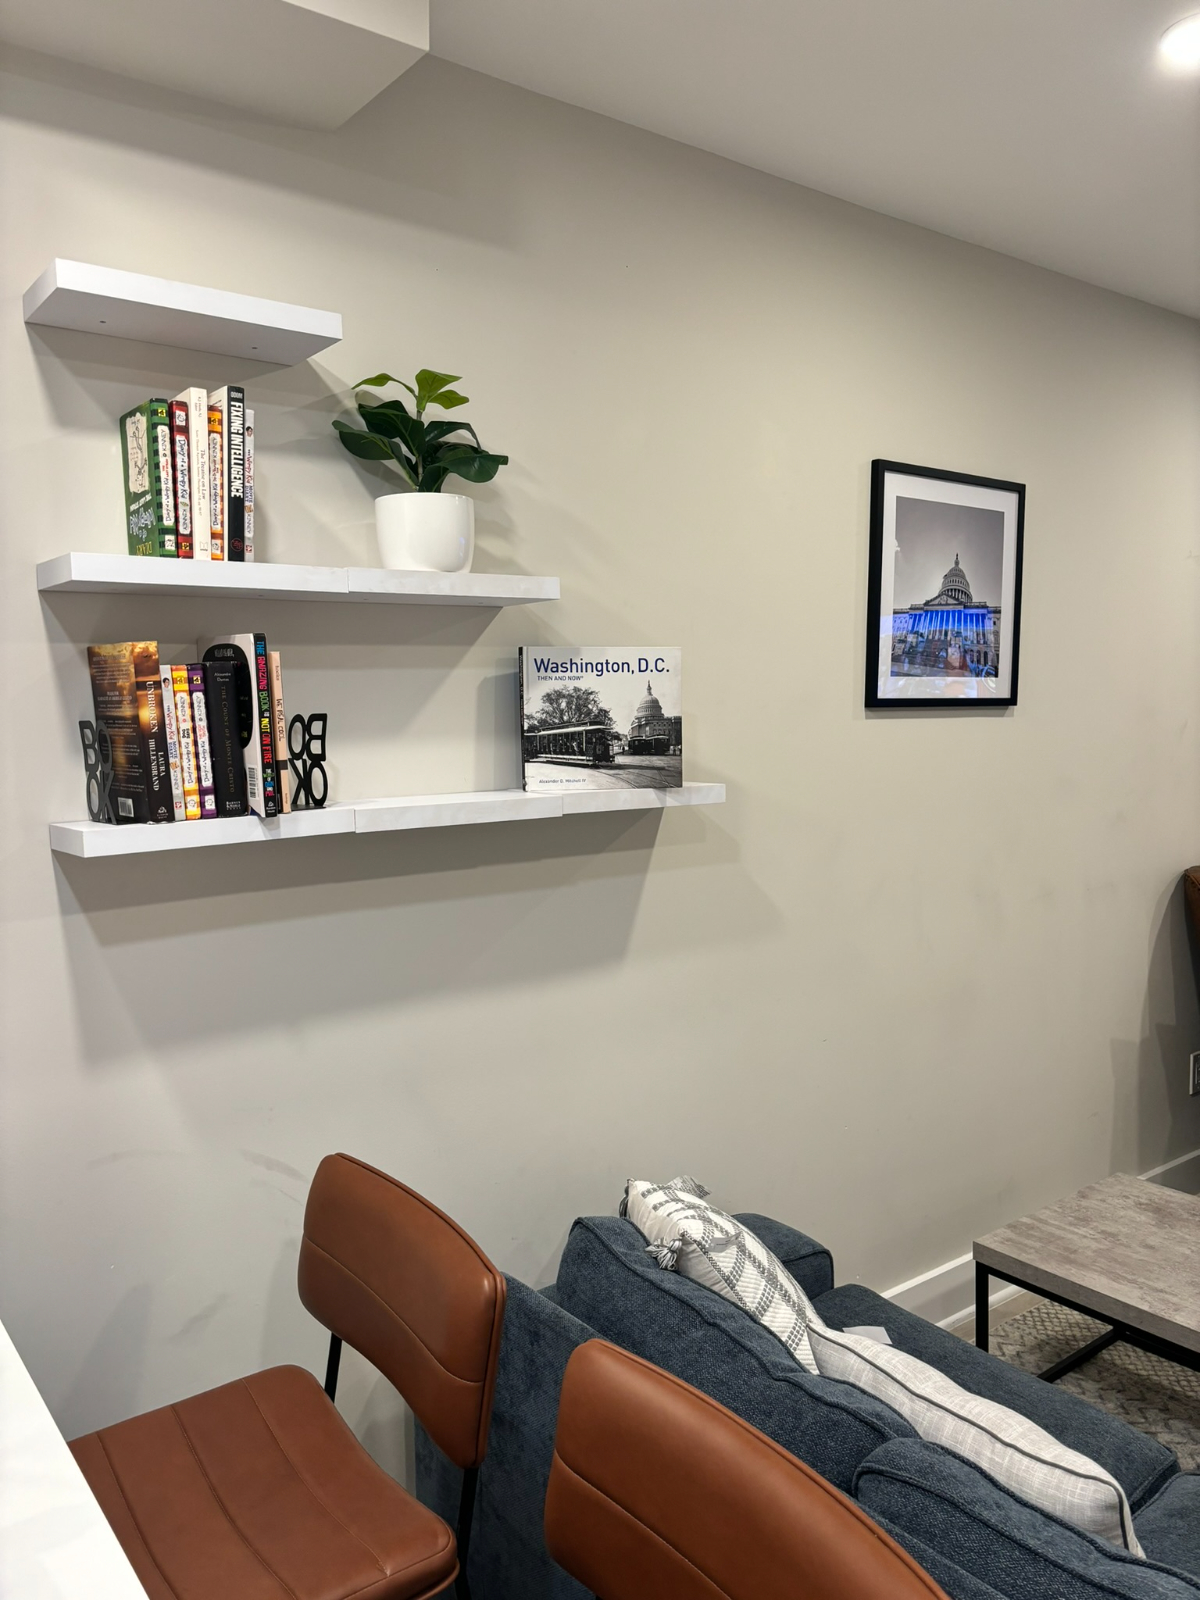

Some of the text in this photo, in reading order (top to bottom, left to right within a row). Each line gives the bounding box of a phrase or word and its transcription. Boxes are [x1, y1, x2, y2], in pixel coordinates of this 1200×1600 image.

[178, 439, 186, 457] Diary
[231, 401, 244, 499] FIXING INTELLIGENCE
[256, 641, 266, 655] THE
[257, 656, 268, 690] AMAZING
[534, 658, 670, 677] Washington, D.C.
[146, 681, 159, 733] UNBROKEN
[259, 691, 270, 711] BOOK
[276, 698, 283, 708] WE
[261, 718, 270, 732] NOT
[168, 730, 176, 741] Kid
[262, 733, 271, 744] ON
[158, 752, 166, 776] LAURA
[263, 746, 273, 764] FIRE
[149, 739, 160, 791] HILLENBRAND
